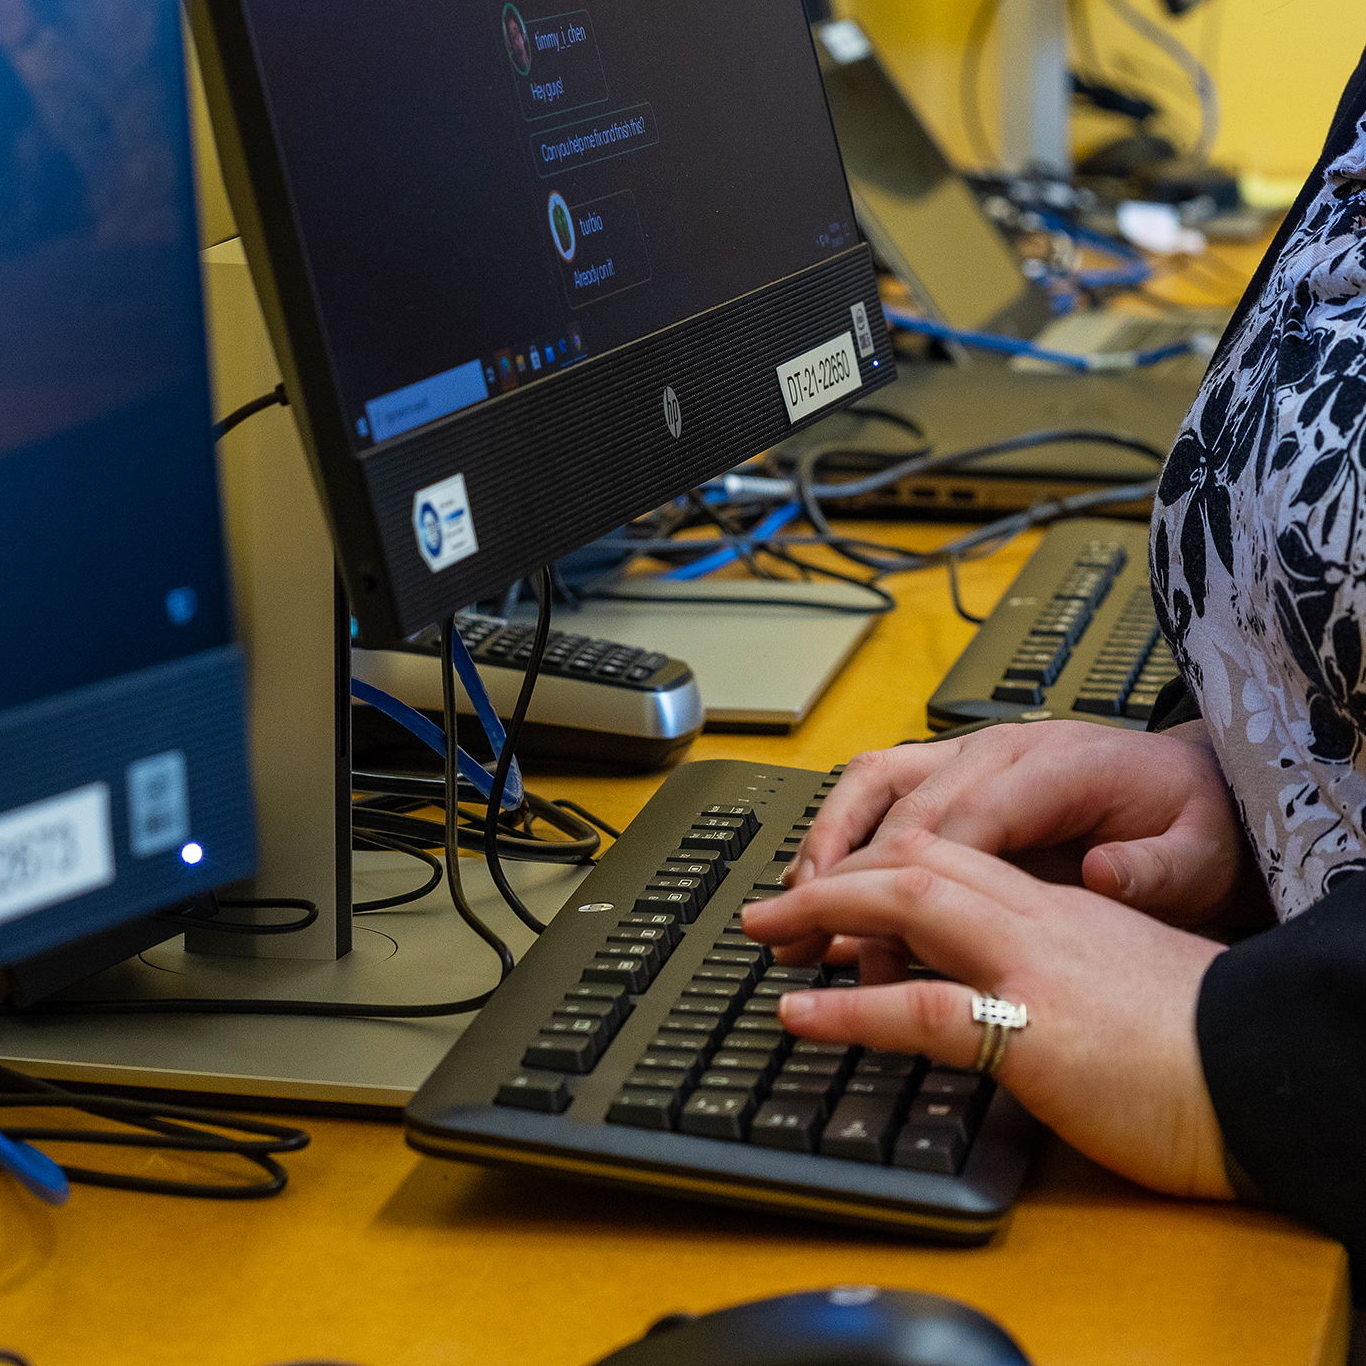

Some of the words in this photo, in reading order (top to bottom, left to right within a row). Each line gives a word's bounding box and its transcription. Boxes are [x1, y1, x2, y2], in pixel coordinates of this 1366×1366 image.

[534, 23, 587, 52] timmy_i_chen
[530, 82, 547, 104] Hey
[541, 143, 559, 162] Can
[556, 141, 571, 163] you
[568, 134, 585, 156] help
[583, 135, 596, 150] me
[602, 124, 616, 144] and
[614, 120, 633, 140] finish
[573, 264, 601, 289] Already
[599, 264, 610, 280] on
[786, 349, 851, 407] DT-21-22650
